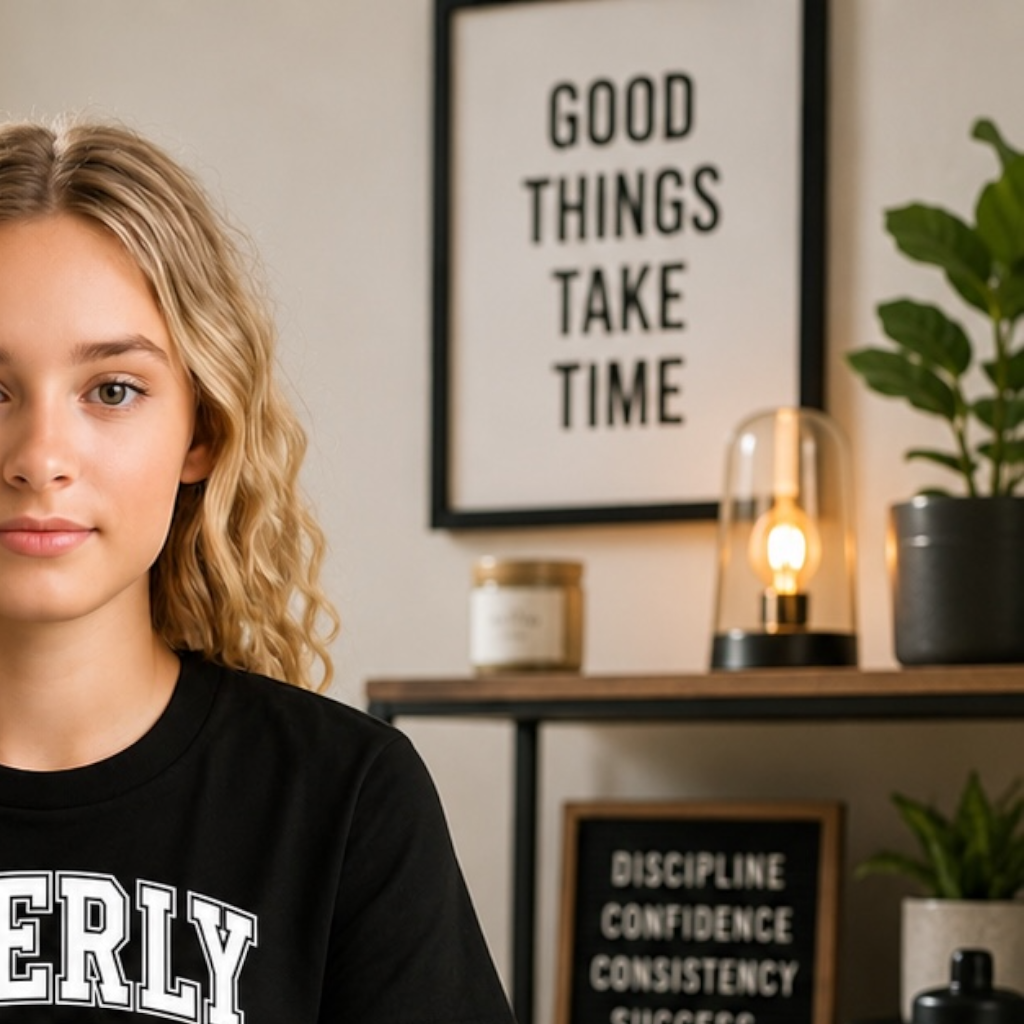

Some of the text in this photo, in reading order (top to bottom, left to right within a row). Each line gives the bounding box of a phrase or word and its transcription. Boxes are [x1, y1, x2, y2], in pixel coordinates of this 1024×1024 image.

[549, 72, 694, 149] GOOD
[523, 165, 722, 243] THINGS
[552, 262, 687, 336] TAKE
[553, 357, 684, 430] TIME
[611, 850, 786, 890] DISCIPLINE
[601, 903, 793, 943] CONFIDENCE
[590, 955, 797, 996] CONSISTENCY
